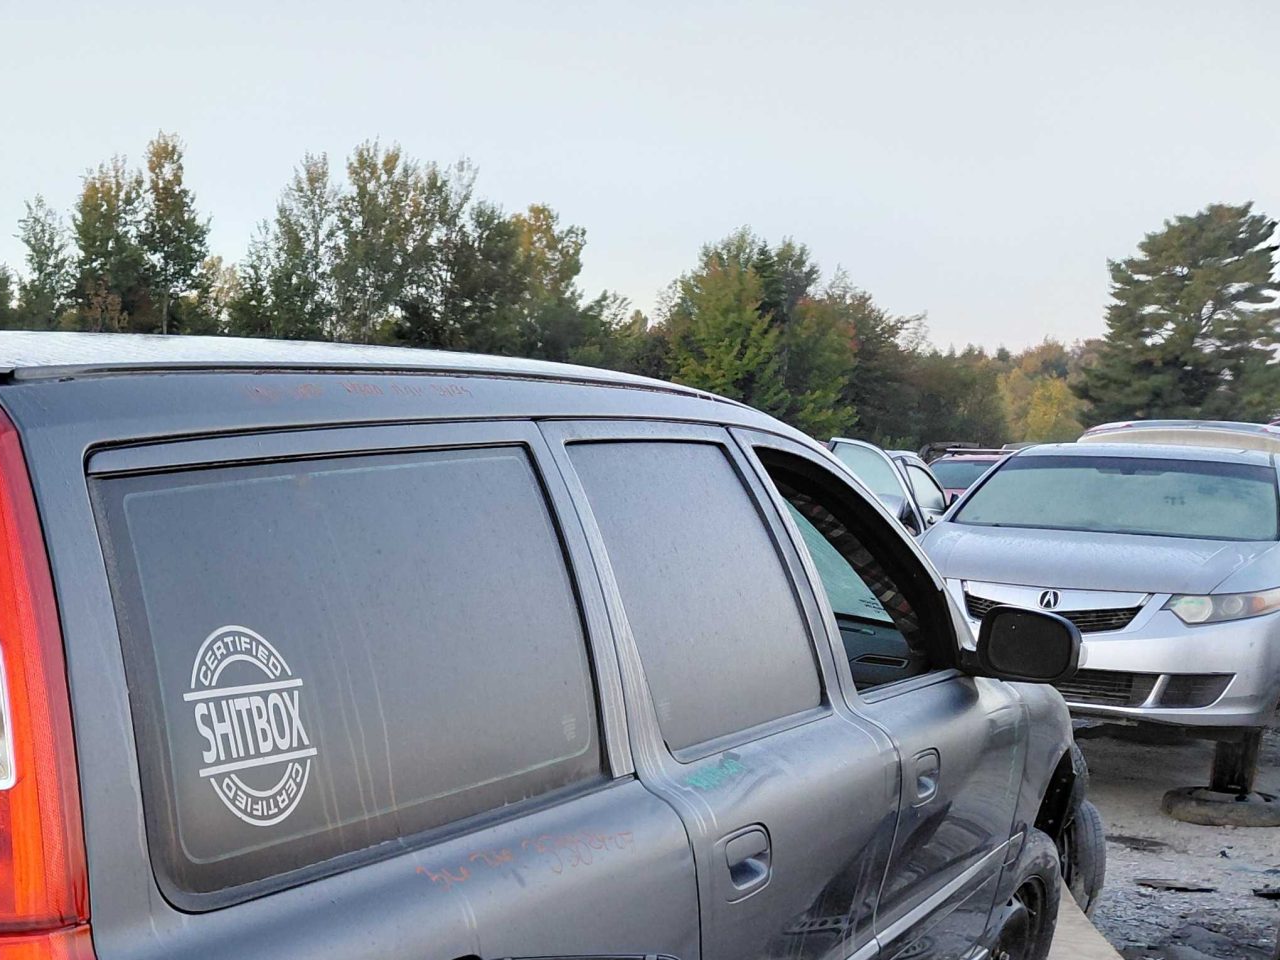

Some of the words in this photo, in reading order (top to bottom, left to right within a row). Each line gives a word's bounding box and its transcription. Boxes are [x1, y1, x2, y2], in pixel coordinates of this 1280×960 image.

[199, 636, 281, 686] CERTIFIED
[194, 690, 310, 764] SHITBOX
[222, 762, 302, 816] CERTIFIED
